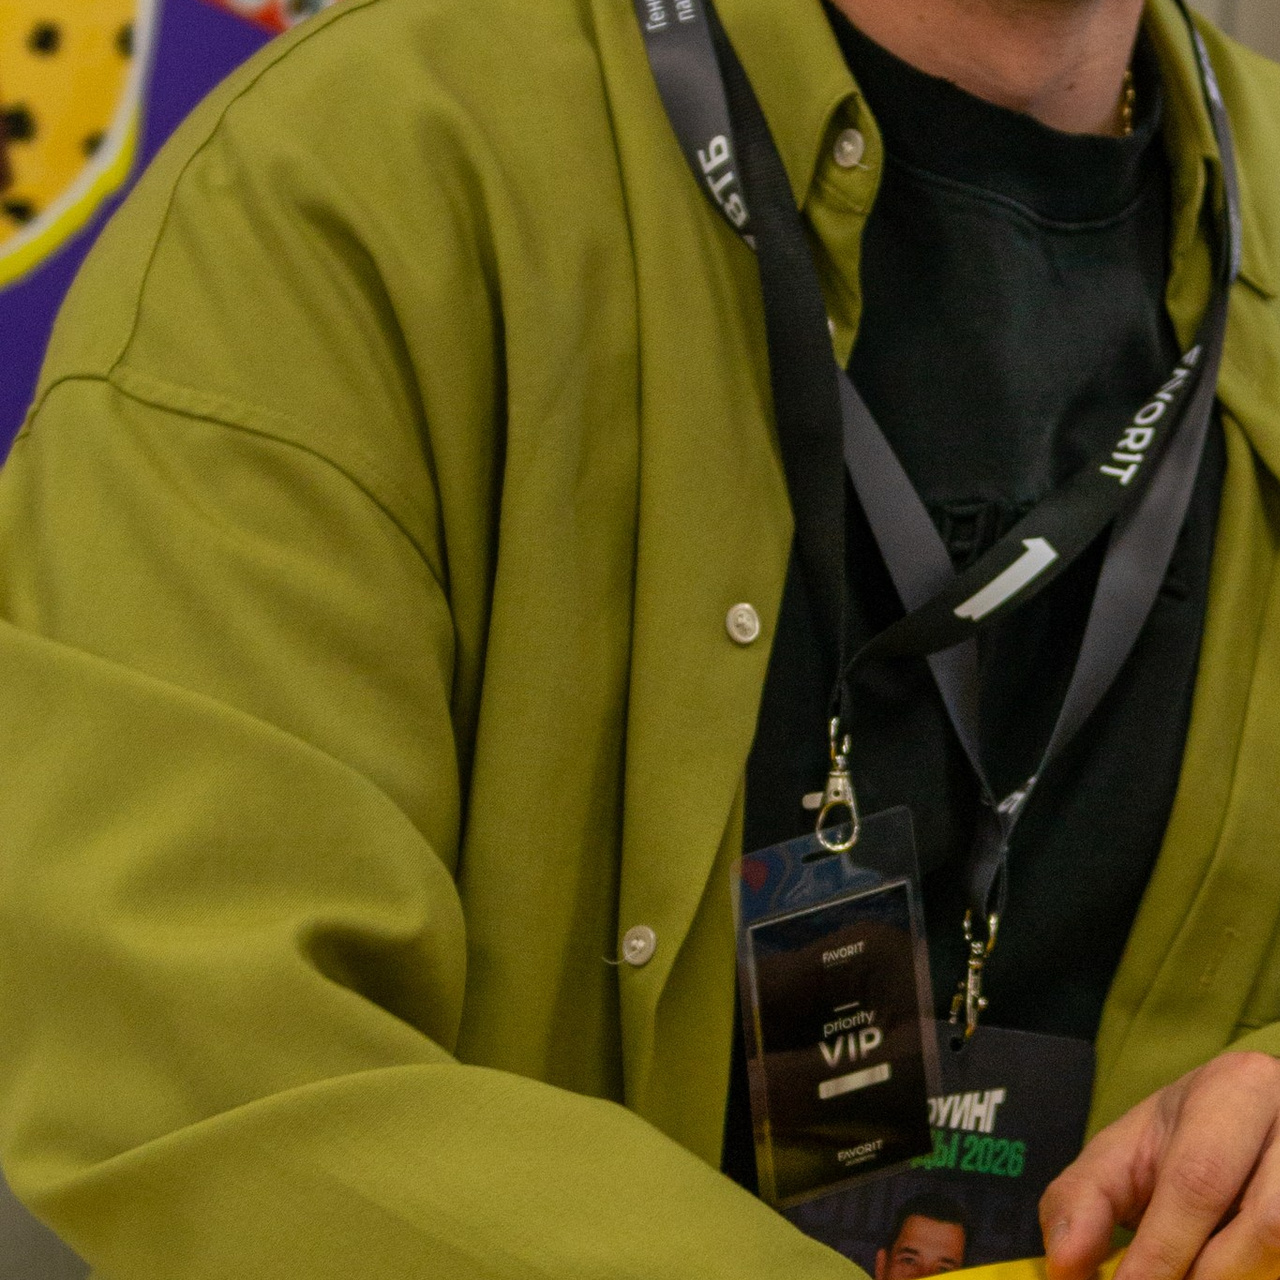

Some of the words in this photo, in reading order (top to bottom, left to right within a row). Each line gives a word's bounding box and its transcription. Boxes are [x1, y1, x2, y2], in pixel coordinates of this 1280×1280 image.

[697, 134, 749, 229] ВТБ
[822, 940, 865, 964] FAVORIT
[823, 1009, 876, 1038] priority
[817, 1025, 883, 1069] VIP
[837, 1139, 884, 1163] FAVORIT
[960, 1135, 1027, 1178] 2026
